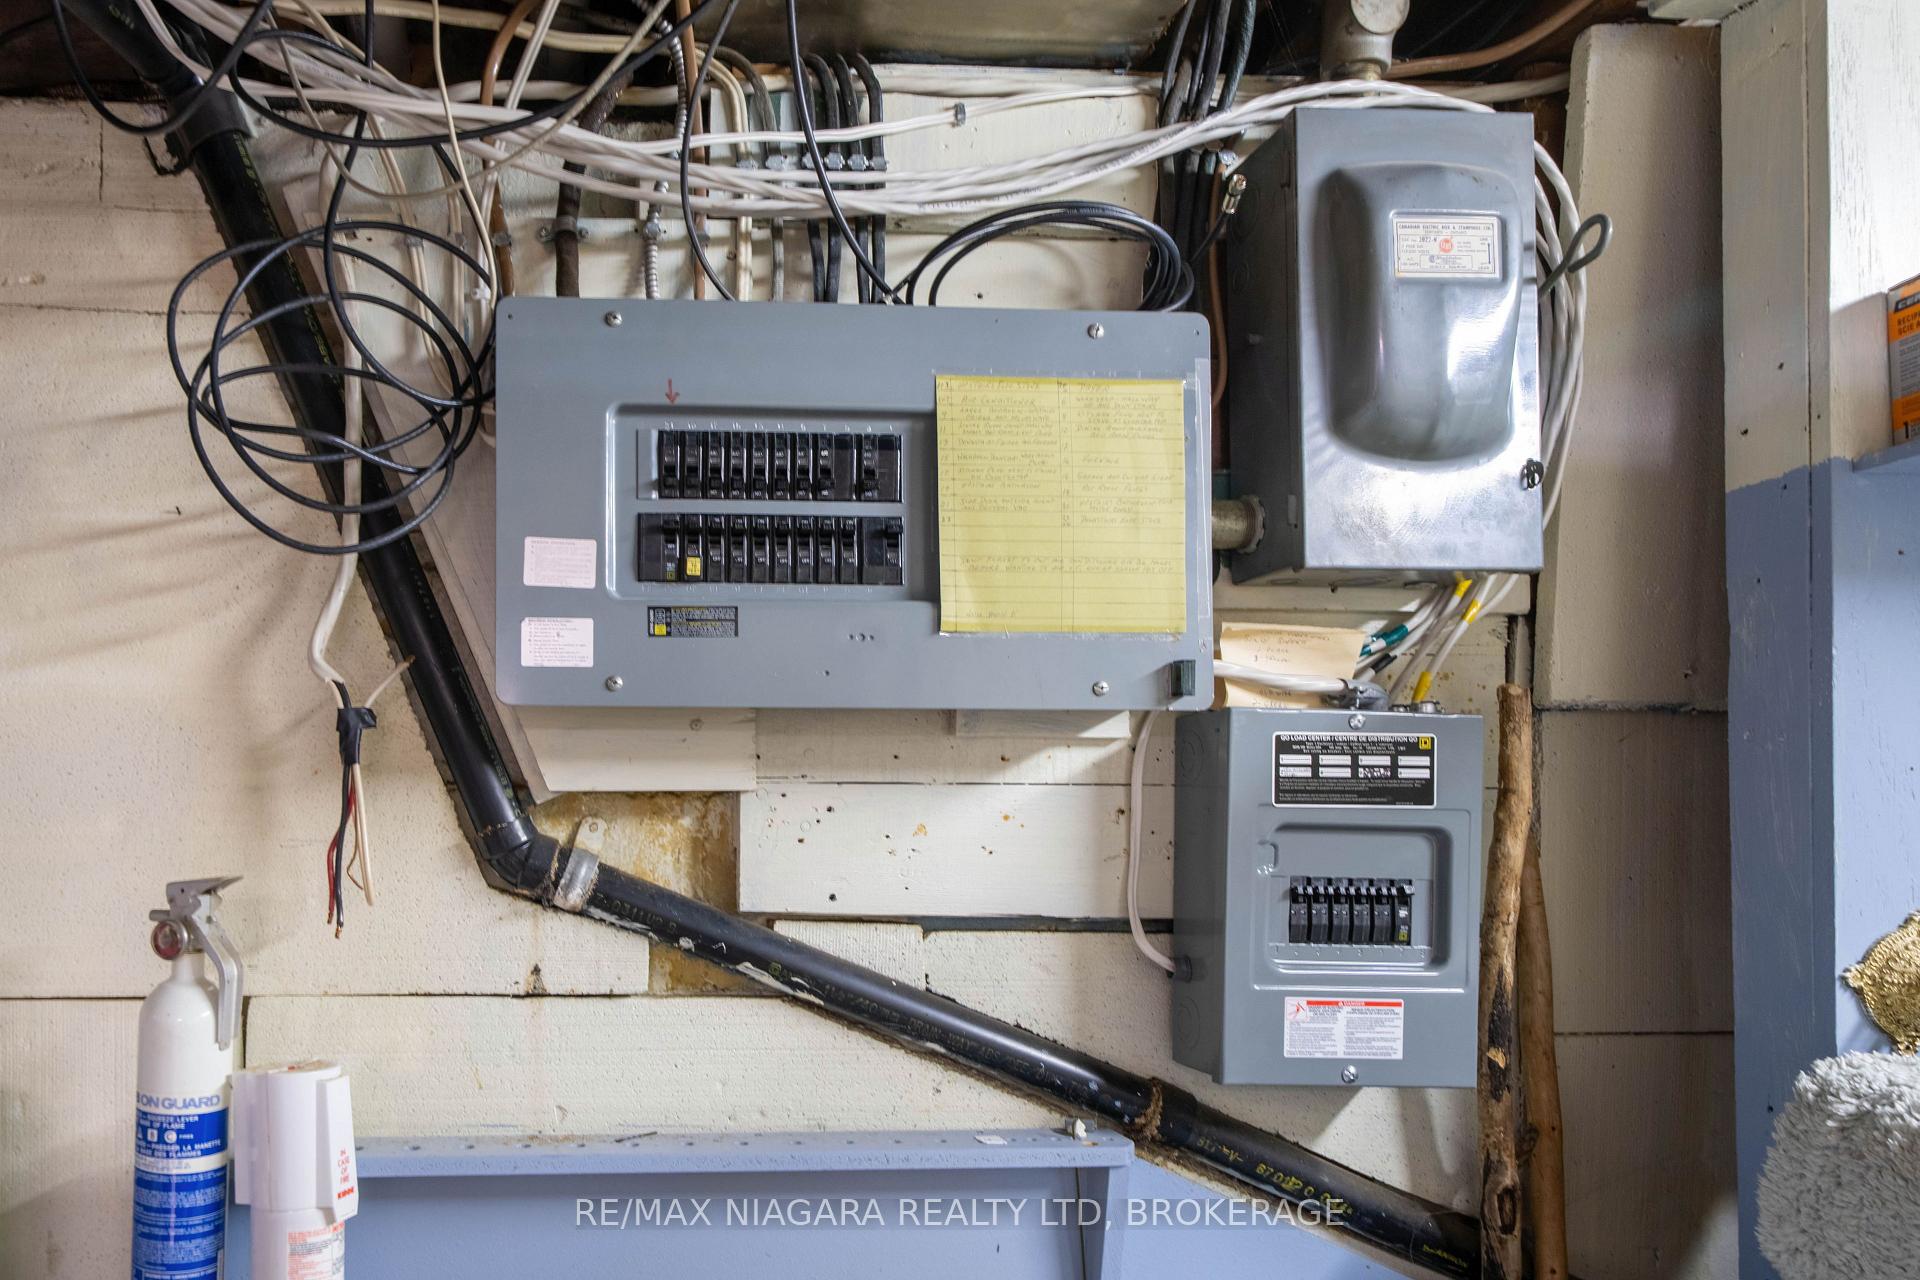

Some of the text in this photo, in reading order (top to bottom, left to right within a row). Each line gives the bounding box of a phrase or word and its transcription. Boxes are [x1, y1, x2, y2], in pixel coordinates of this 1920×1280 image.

[1335, 734, 1358, 742] CENTRE
[161, 1094, 221, 1110] GUARD
[195, 1139, 221, 1150] MANETTE
